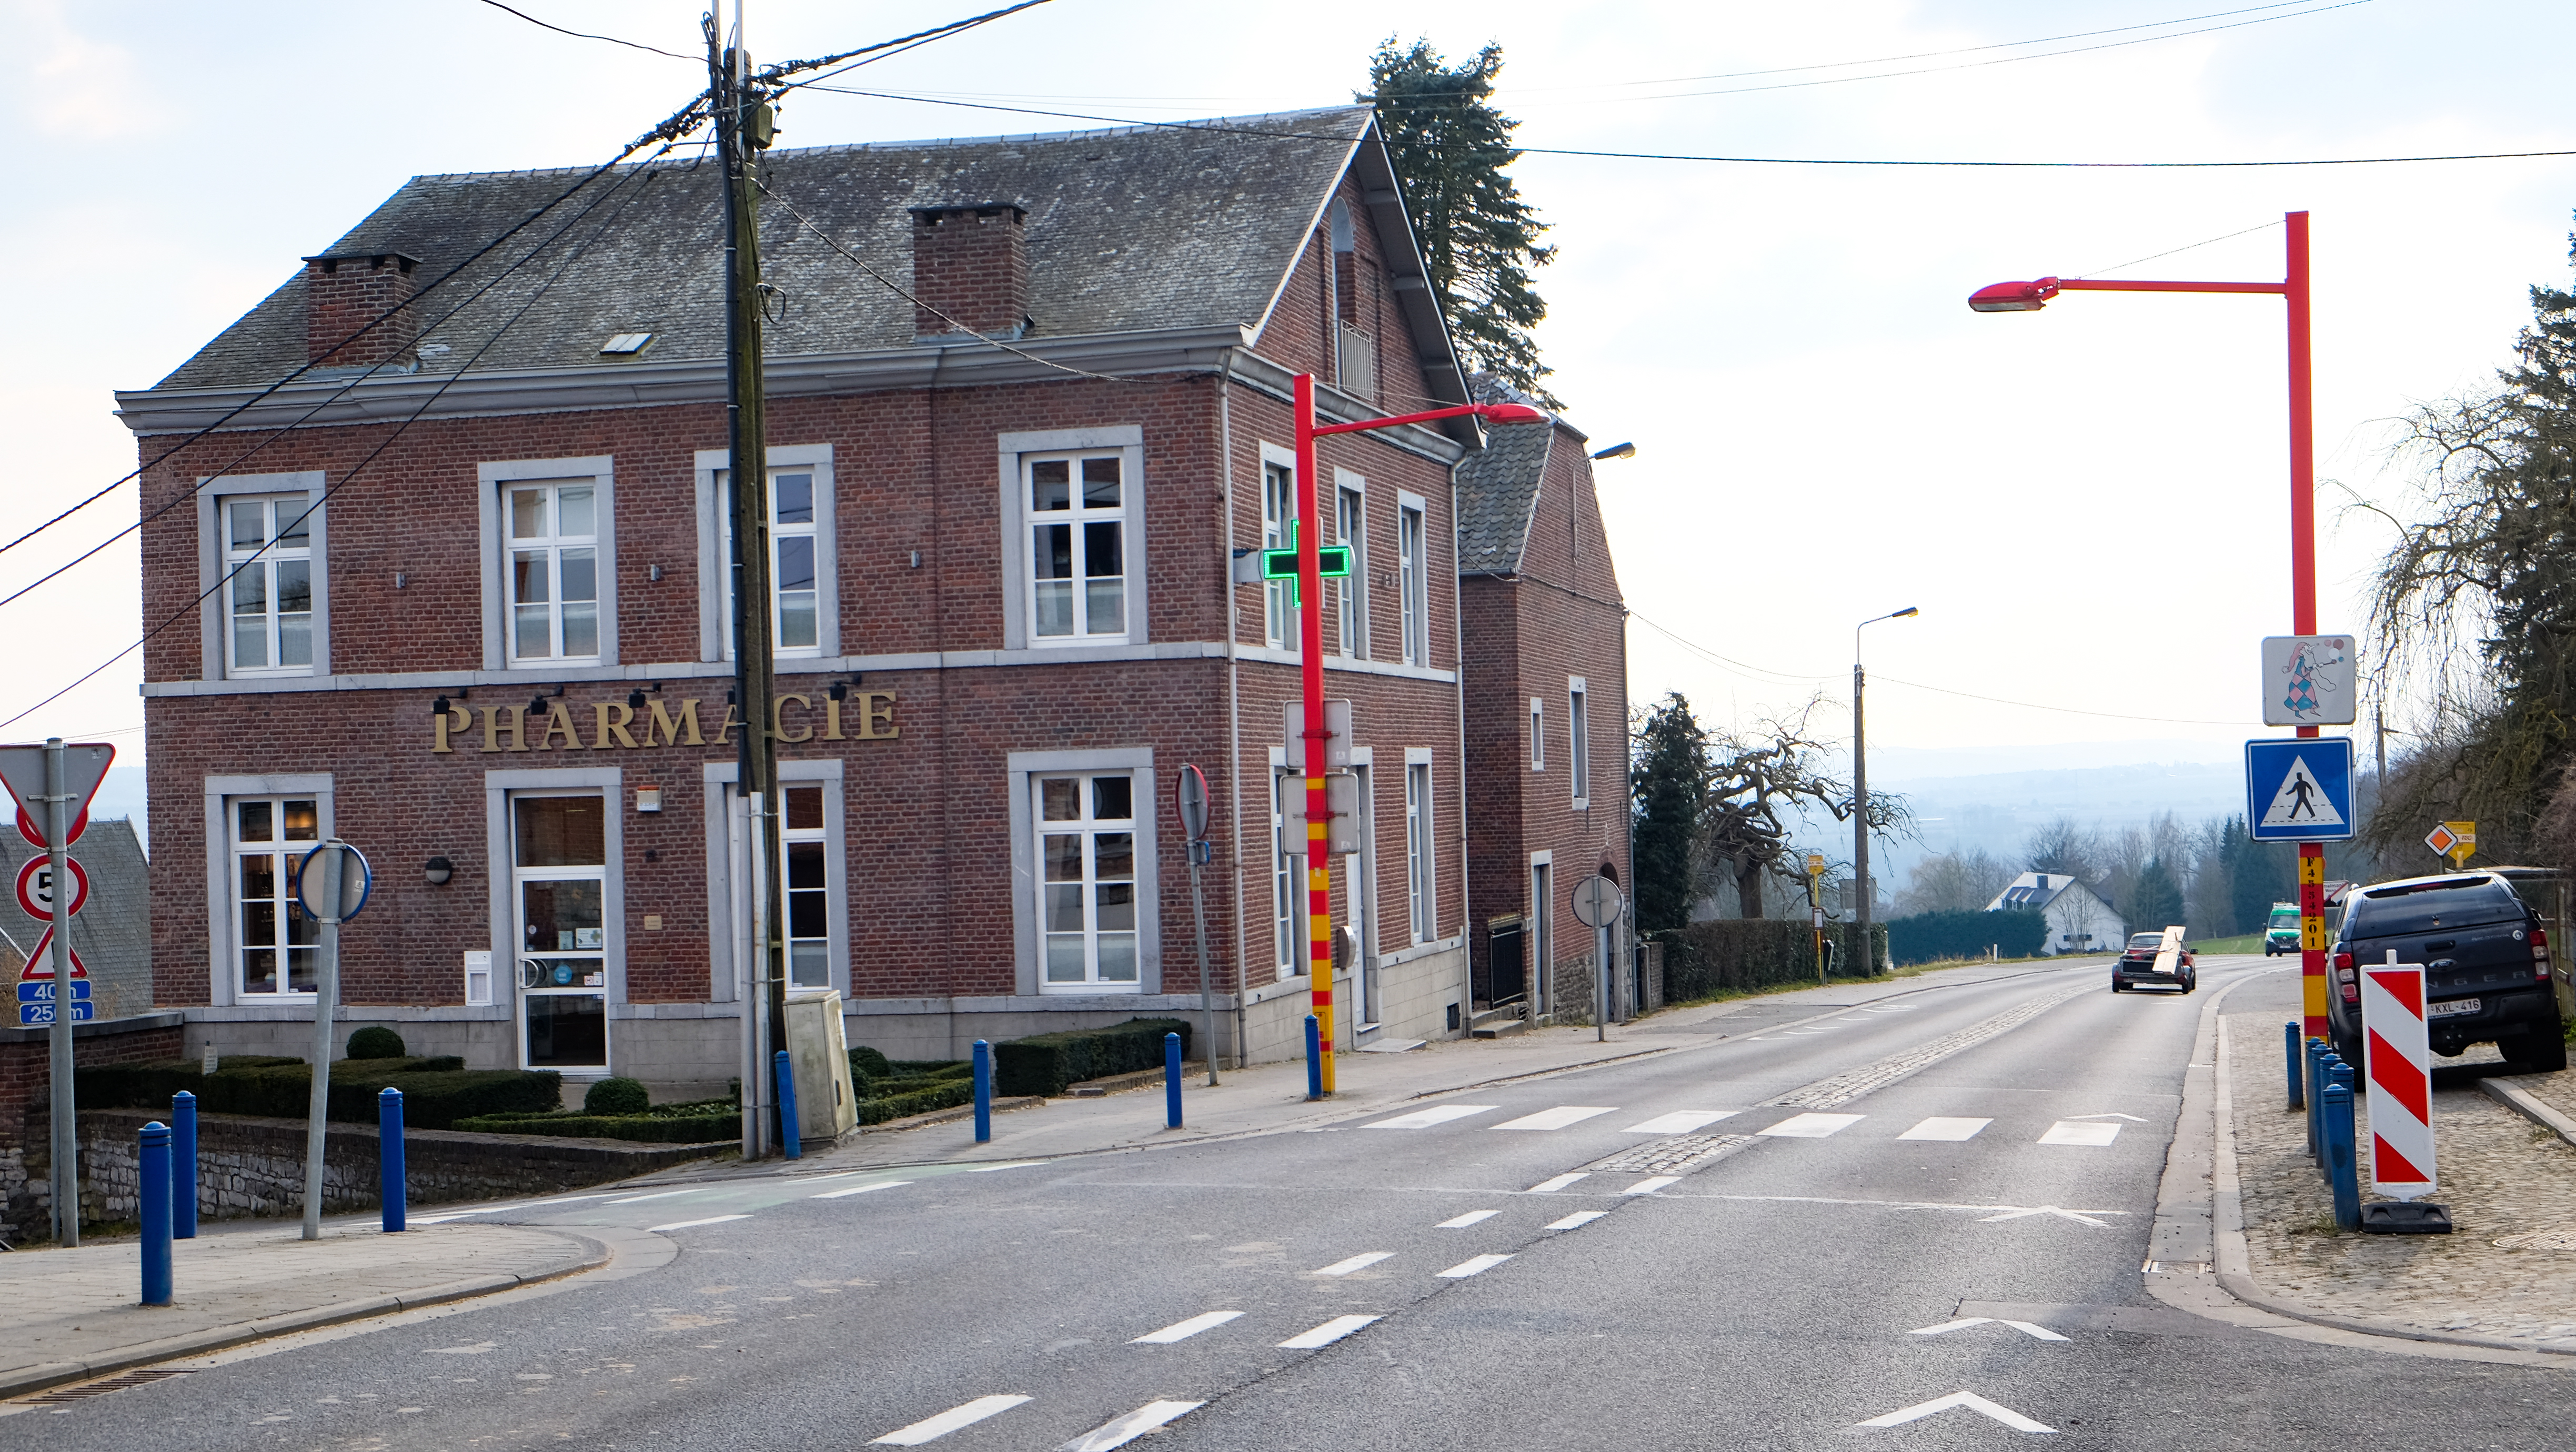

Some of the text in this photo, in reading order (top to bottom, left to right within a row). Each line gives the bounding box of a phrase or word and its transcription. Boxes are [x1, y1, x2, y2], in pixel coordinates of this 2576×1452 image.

[2426, 971, 2527, 989] NGER
[31, 1005, 83, 1022] 25m
[2427, 1000, 2479, 1014] -KXL-416
